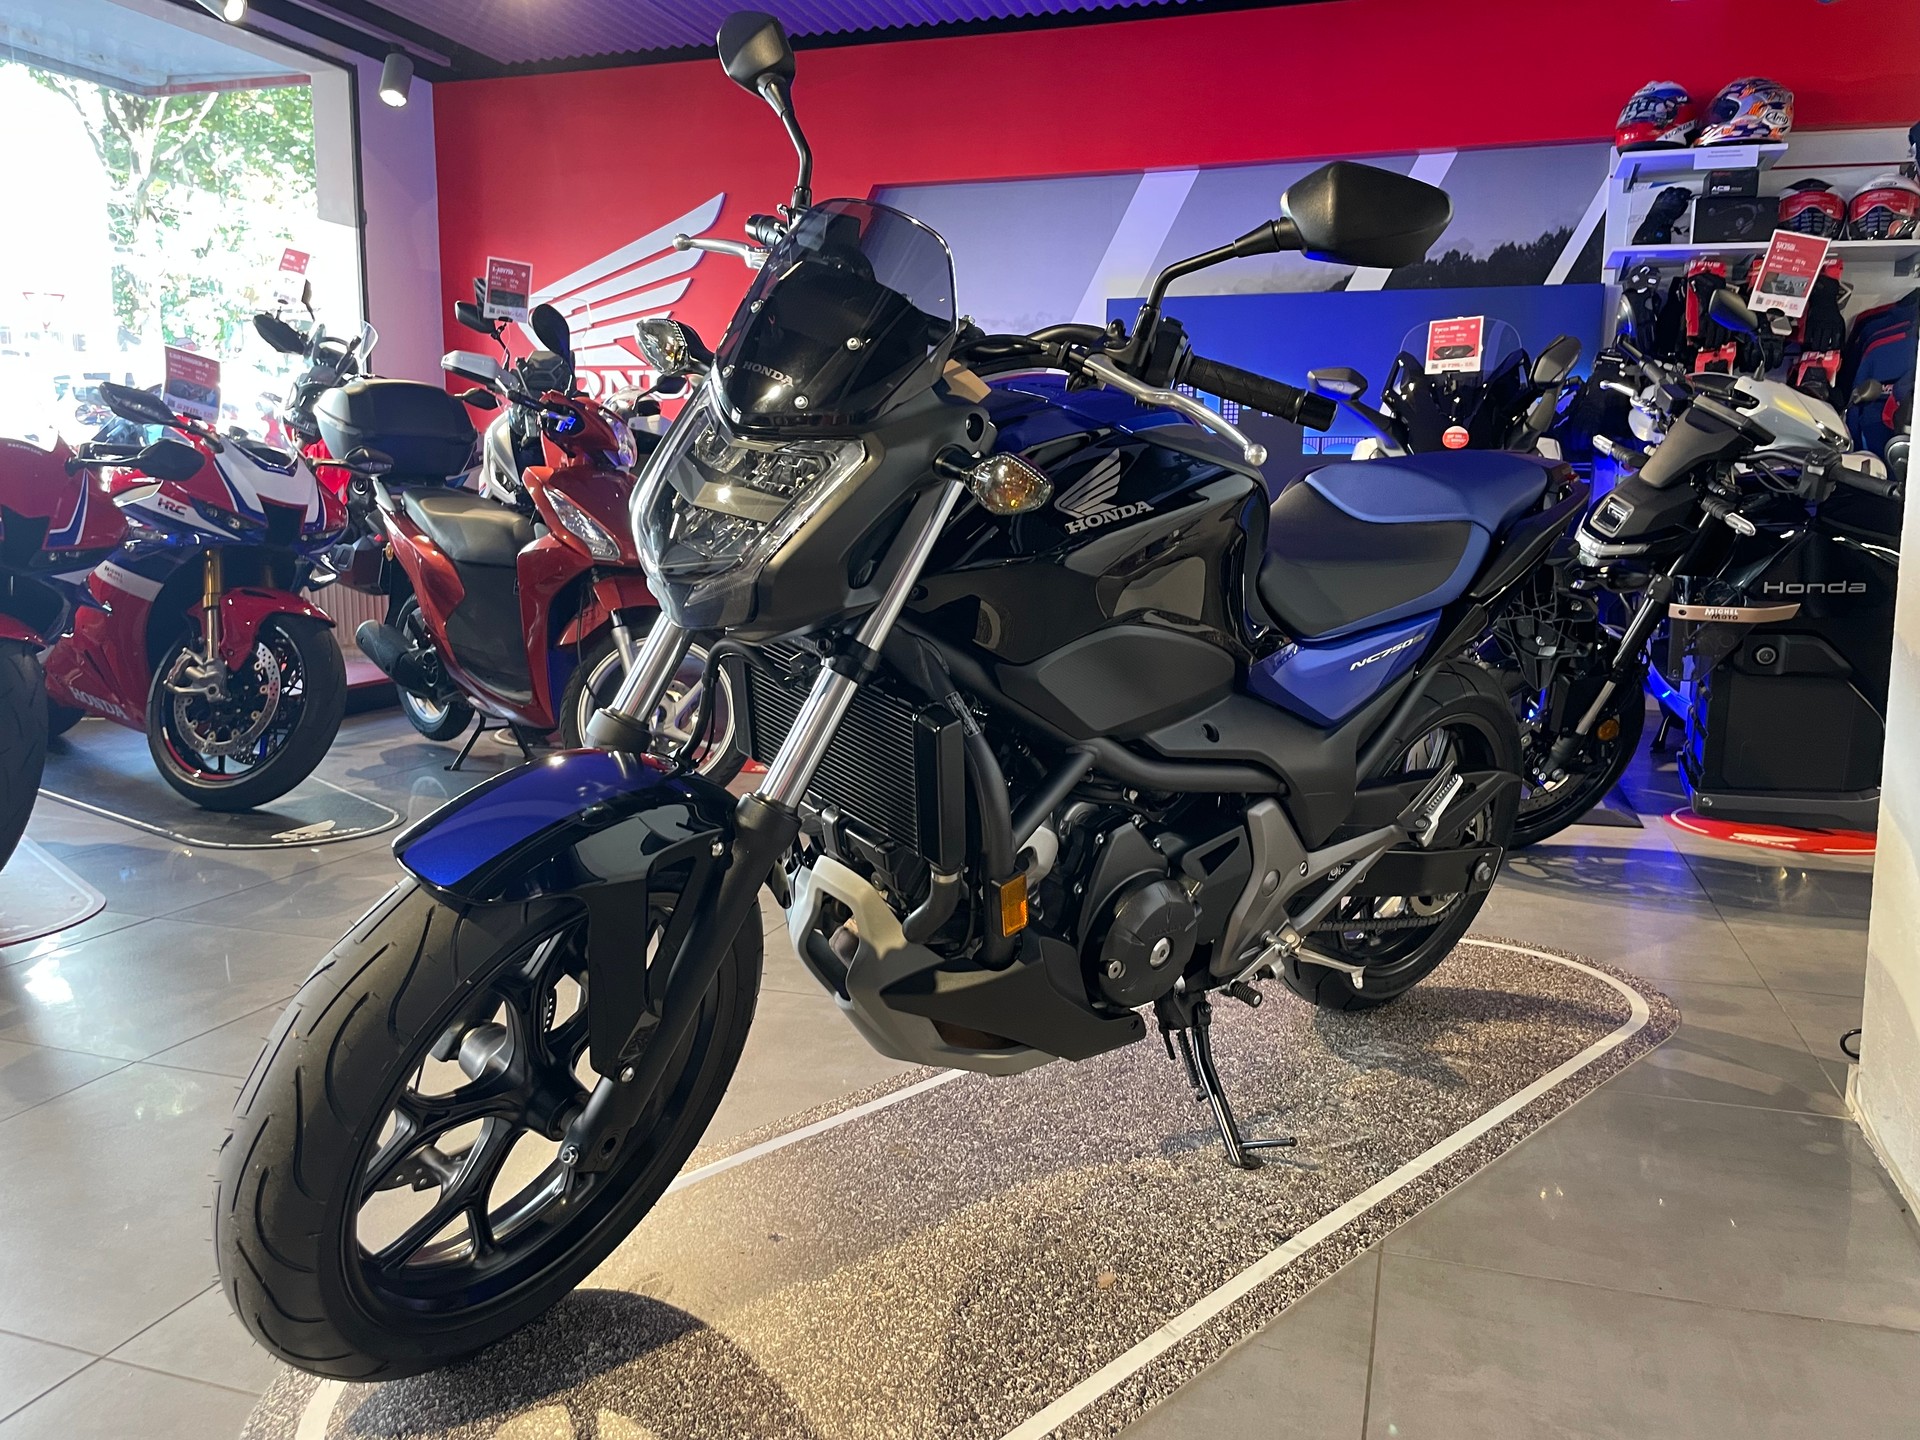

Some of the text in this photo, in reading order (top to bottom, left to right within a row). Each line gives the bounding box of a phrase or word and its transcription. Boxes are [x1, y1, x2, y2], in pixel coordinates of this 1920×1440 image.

[742, 360, 794, 387] HONDA
[157, 497, 187, 516] HRC
[1065, 500, 1155, 535] HONDA
[1763, 580, 1867, 594] Honda
[1704, 608, 1739, 616] MICHEL
[68, 686, 130, 720] HONDA
